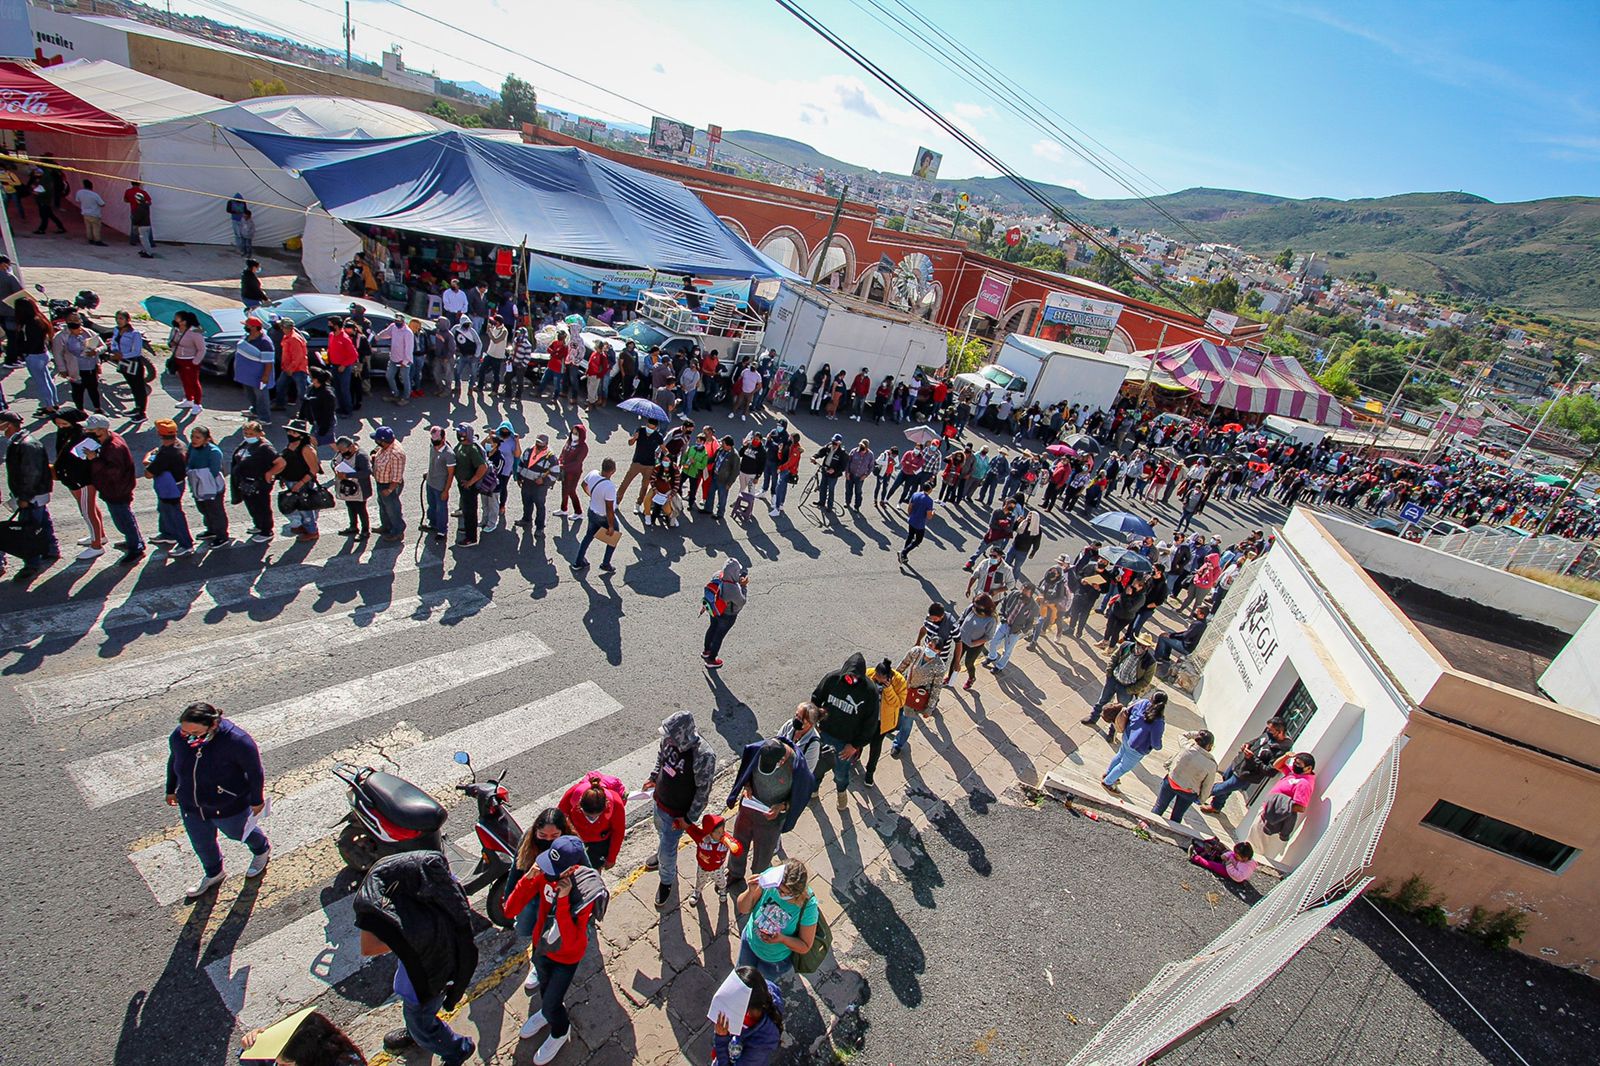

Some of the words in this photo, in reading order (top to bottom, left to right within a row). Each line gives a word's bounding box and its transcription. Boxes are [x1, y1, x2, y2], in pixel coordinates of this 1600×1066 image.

[36, 31, 75, 51] gonzález
[827, 694, 854, 715] PUMA
[663, 743, 686, 770] USA
